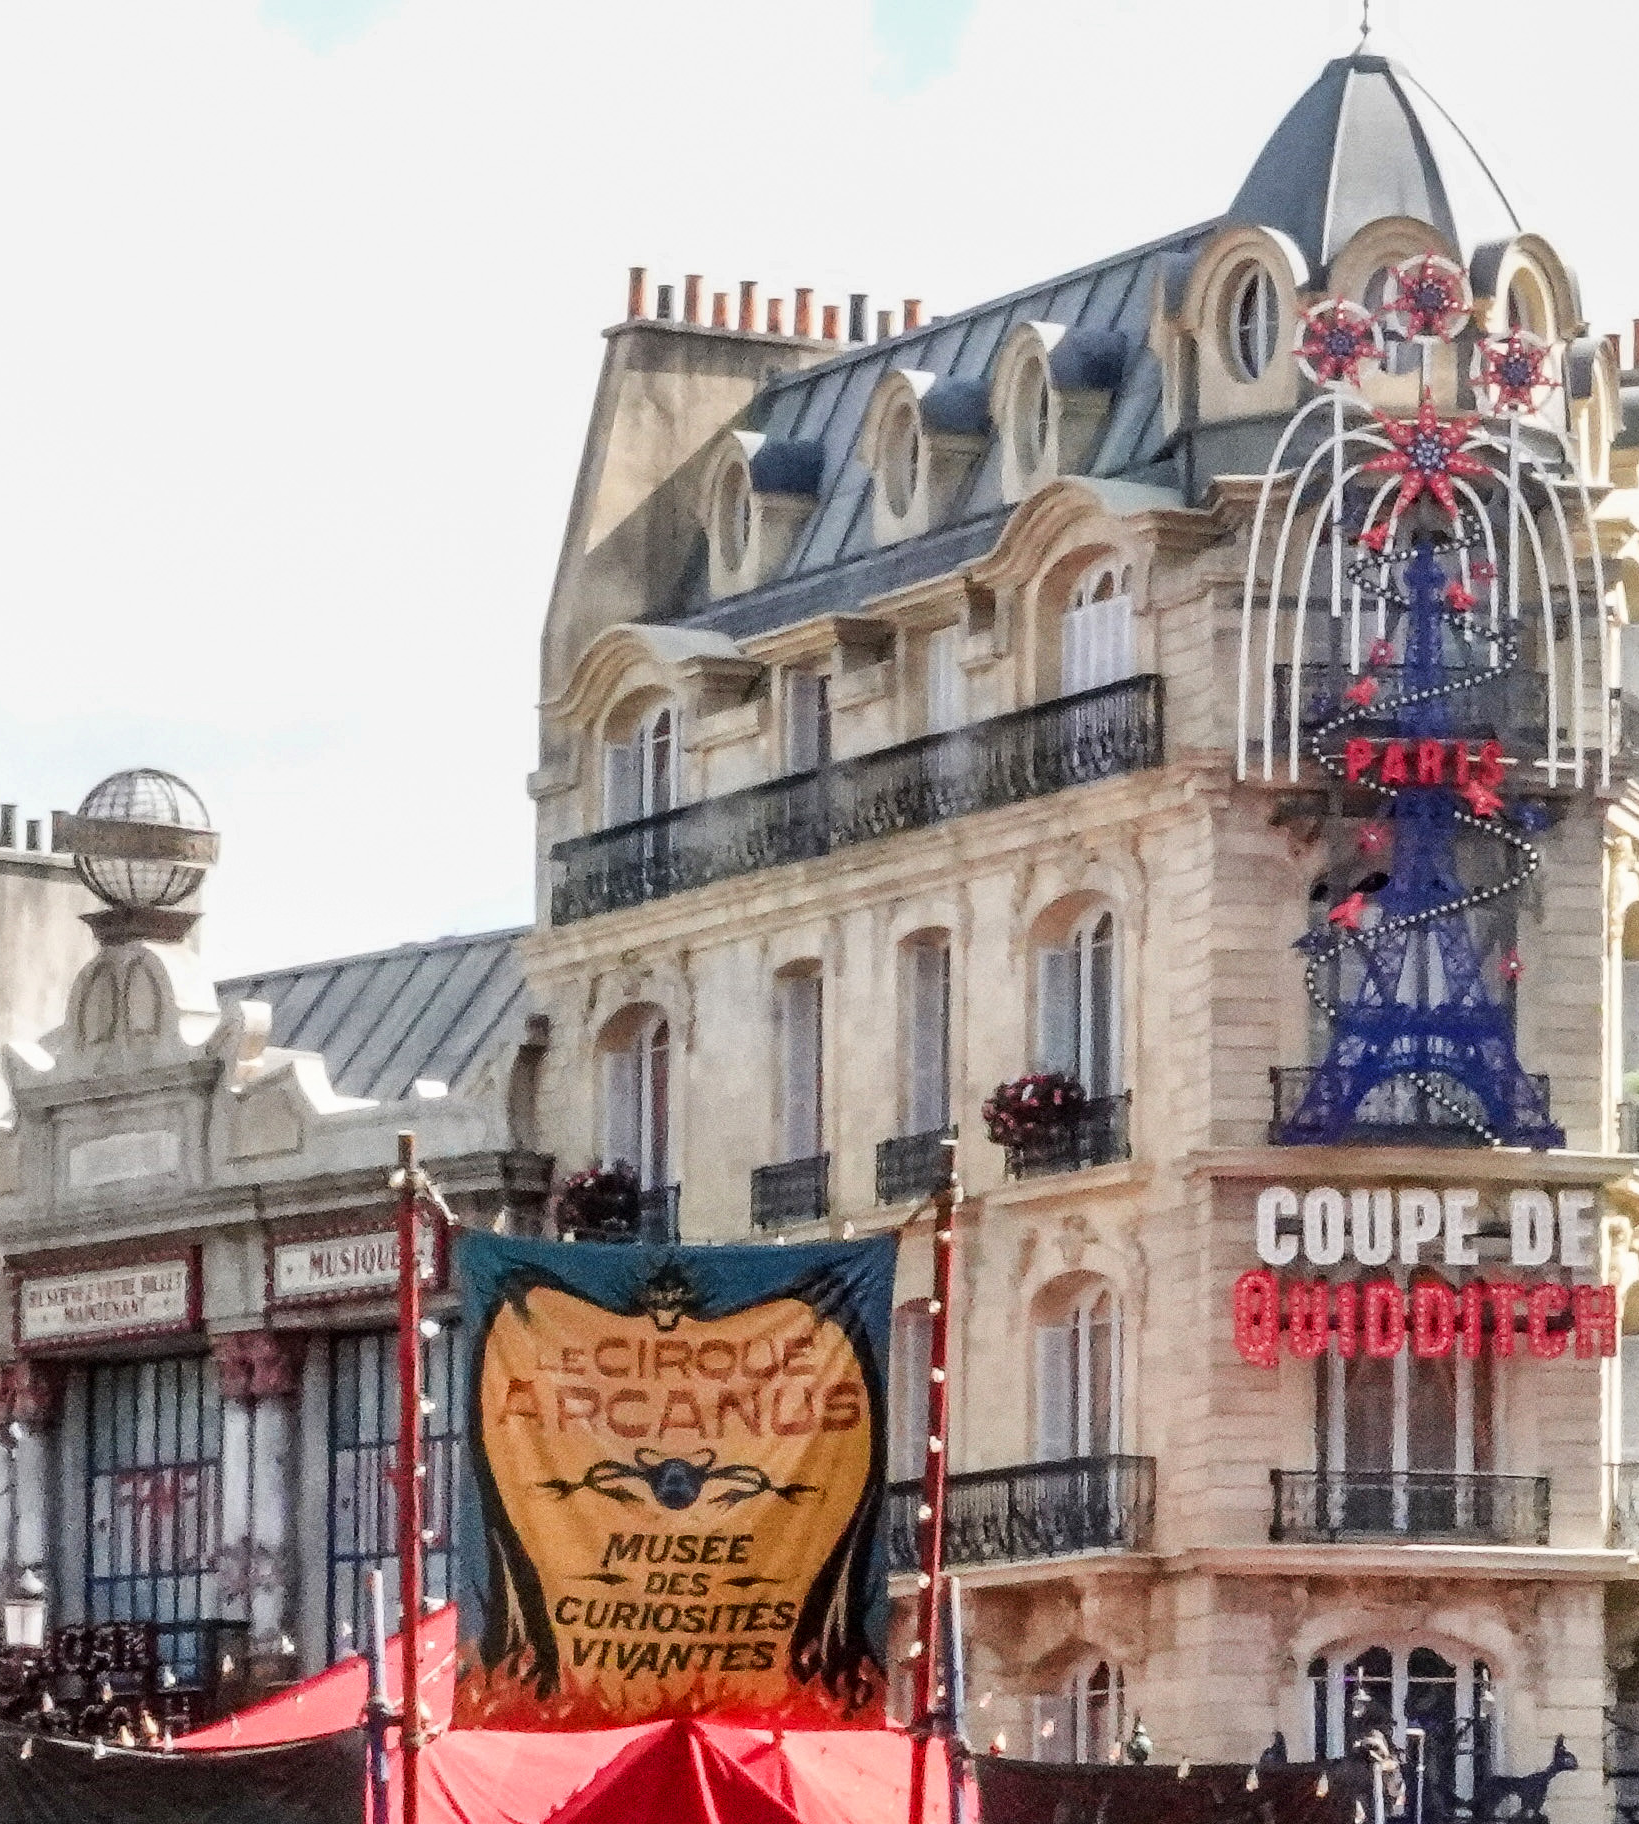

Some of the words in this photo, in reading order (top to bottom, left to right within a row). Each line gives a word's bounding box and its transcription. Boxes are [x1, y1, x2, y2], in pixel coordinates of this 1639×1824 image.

[1345, 737, 1506, 788] PARIS
[1256, 1186, 1480, 1267] COUPE
[1510, 1189, 1597, 1267] DE
[1233, 1269, 1618, 1369] QUIDDITCH
[595, 1334, 818, 1381] CIRQUE
[499, 1379, 862, 1439] ARCANUS
[644, 1571, 711, 1597] DES
[572, 1637, 777, 1681] VIVANTES
